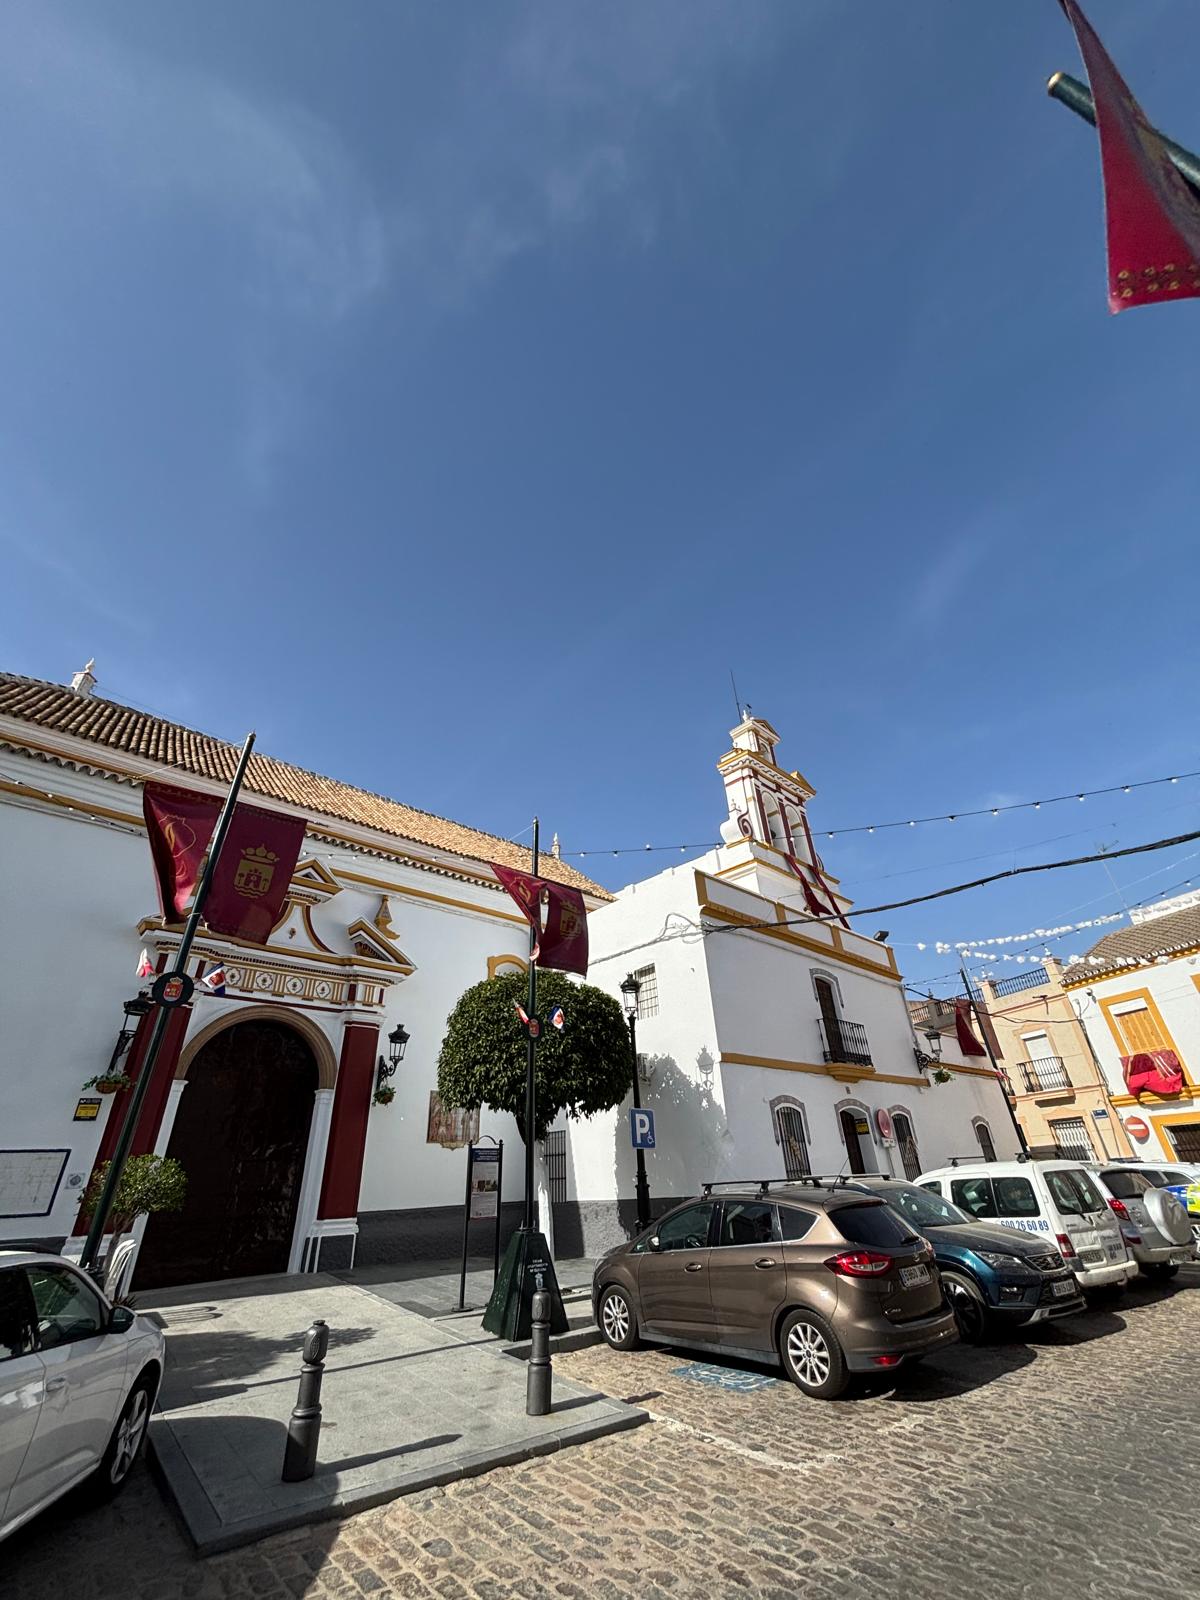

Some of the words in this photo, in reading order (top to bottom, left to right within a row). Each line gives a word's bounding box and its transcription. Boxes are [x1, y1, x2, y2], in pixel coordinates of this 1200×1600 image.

[635, 1113, 650, 1144] P
[1016, 1220, 1026, 1231] 26
[1026, 1220, 1037, 1231] 60
[1038, 1220, 1049, 1231] 89
